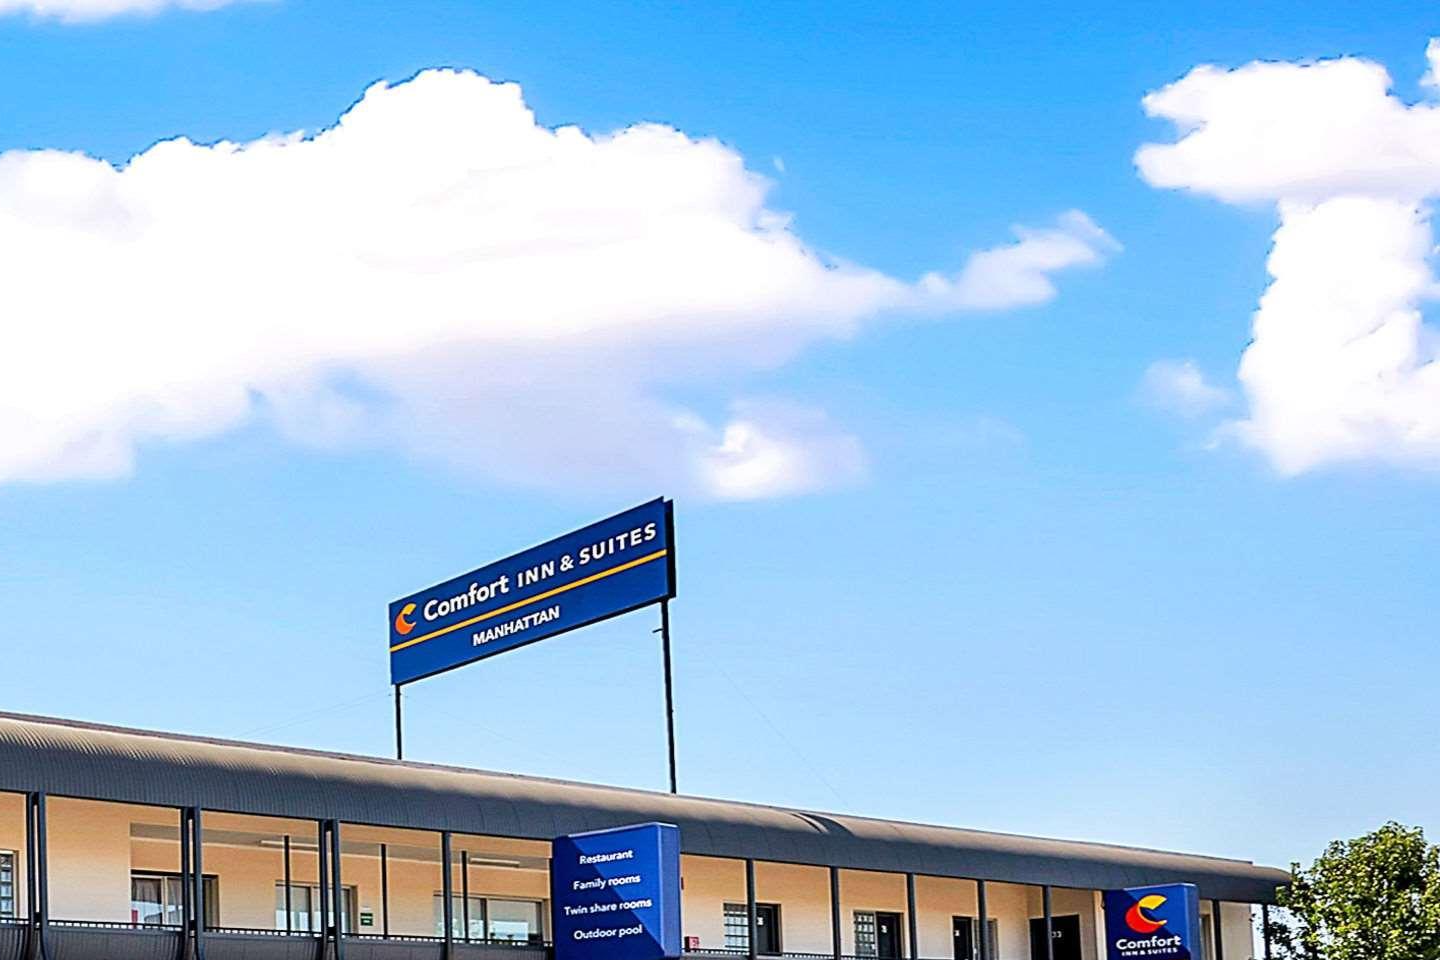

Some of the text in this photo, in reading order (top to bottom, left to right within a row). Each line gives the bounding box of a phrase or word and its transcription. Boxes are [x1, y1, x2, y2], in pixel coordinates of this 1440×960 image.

[423, 522, 657, 620] Comfort INN & SUITES
[472, 605, 560, 646] MANHATTAN
[579, 850, 634, 865] Restaurant
[573, 874, 641, 890] Family rooms
[564, 898, 653, 916] Twin share rooms
[573, 924, 643, 940] Outdoor pool
[1115, 935, 1182, 950] Comfort
[1147, 947, 1178, 955] SUITES
